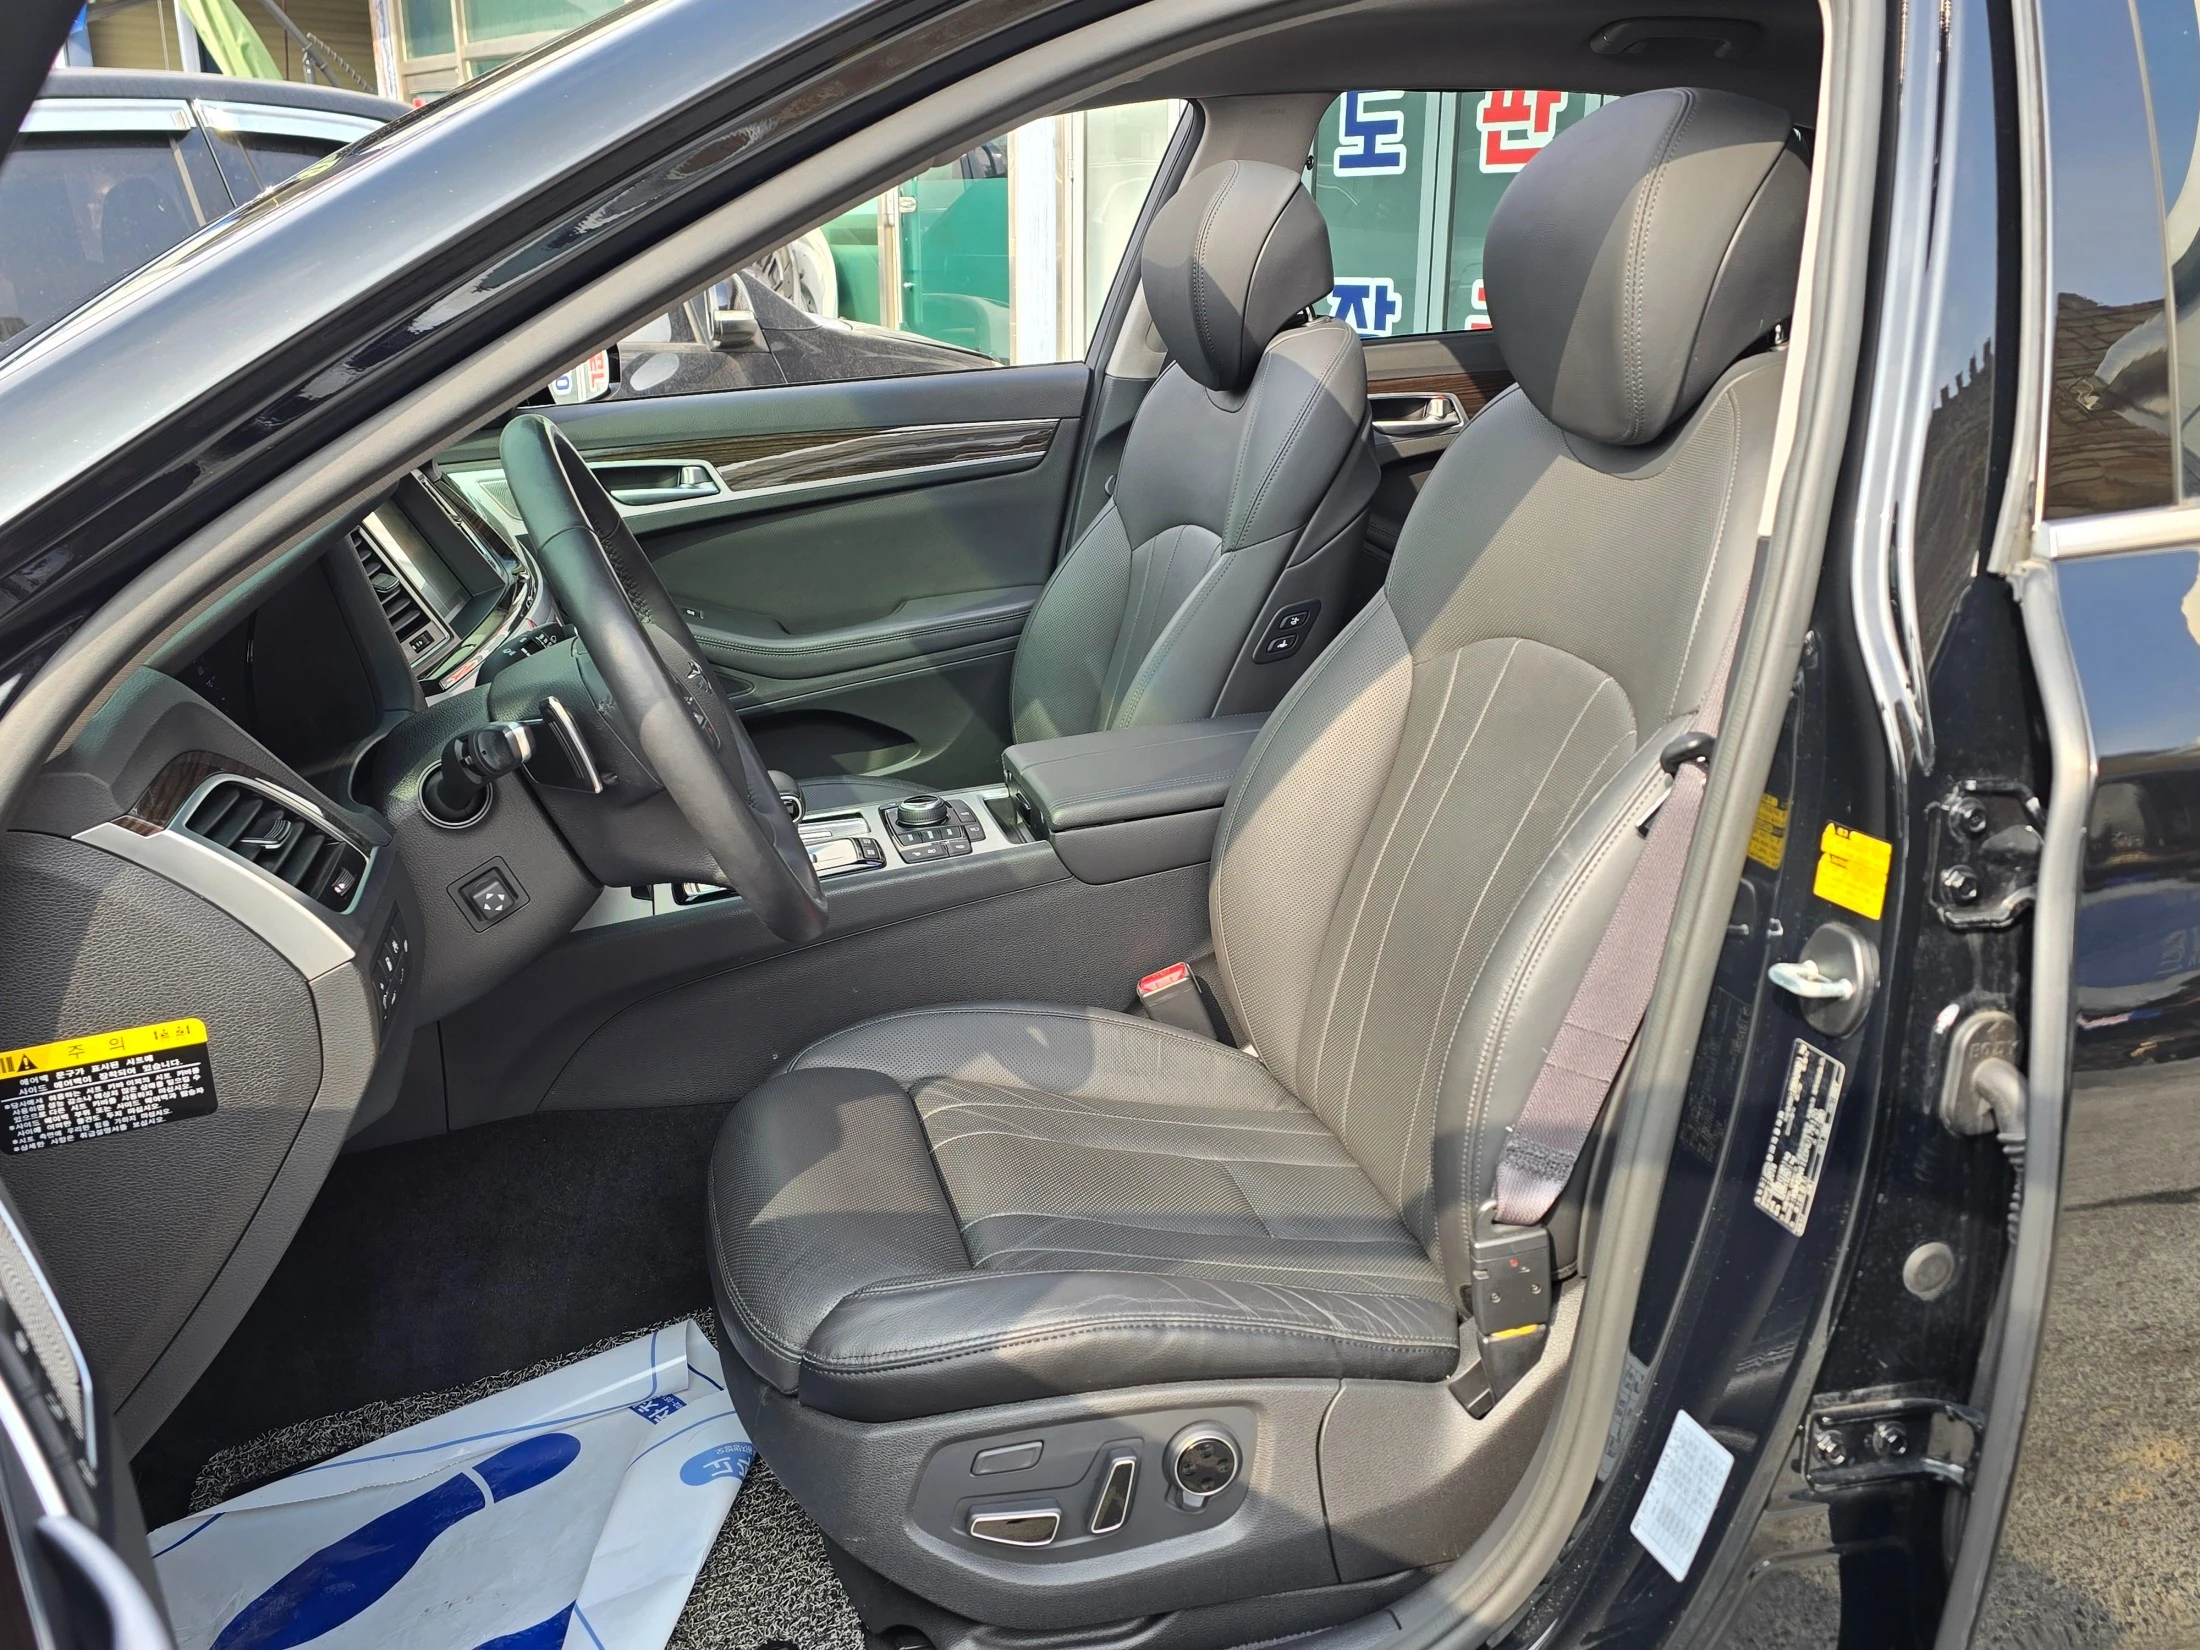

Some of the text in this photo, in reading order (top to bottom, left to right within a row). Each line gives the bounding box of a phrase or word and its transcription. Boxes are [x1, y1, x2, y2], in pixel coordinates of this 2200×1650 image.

[67, 1037, 125, 1060] 주 의
[18, 1085, 47, 1096] 사이드
[53, 1076, 92, 1089] 에어백이
[143, 1059, 183, 1072] 있습니다.
[20, 1075, 49, 1086] 에어백
